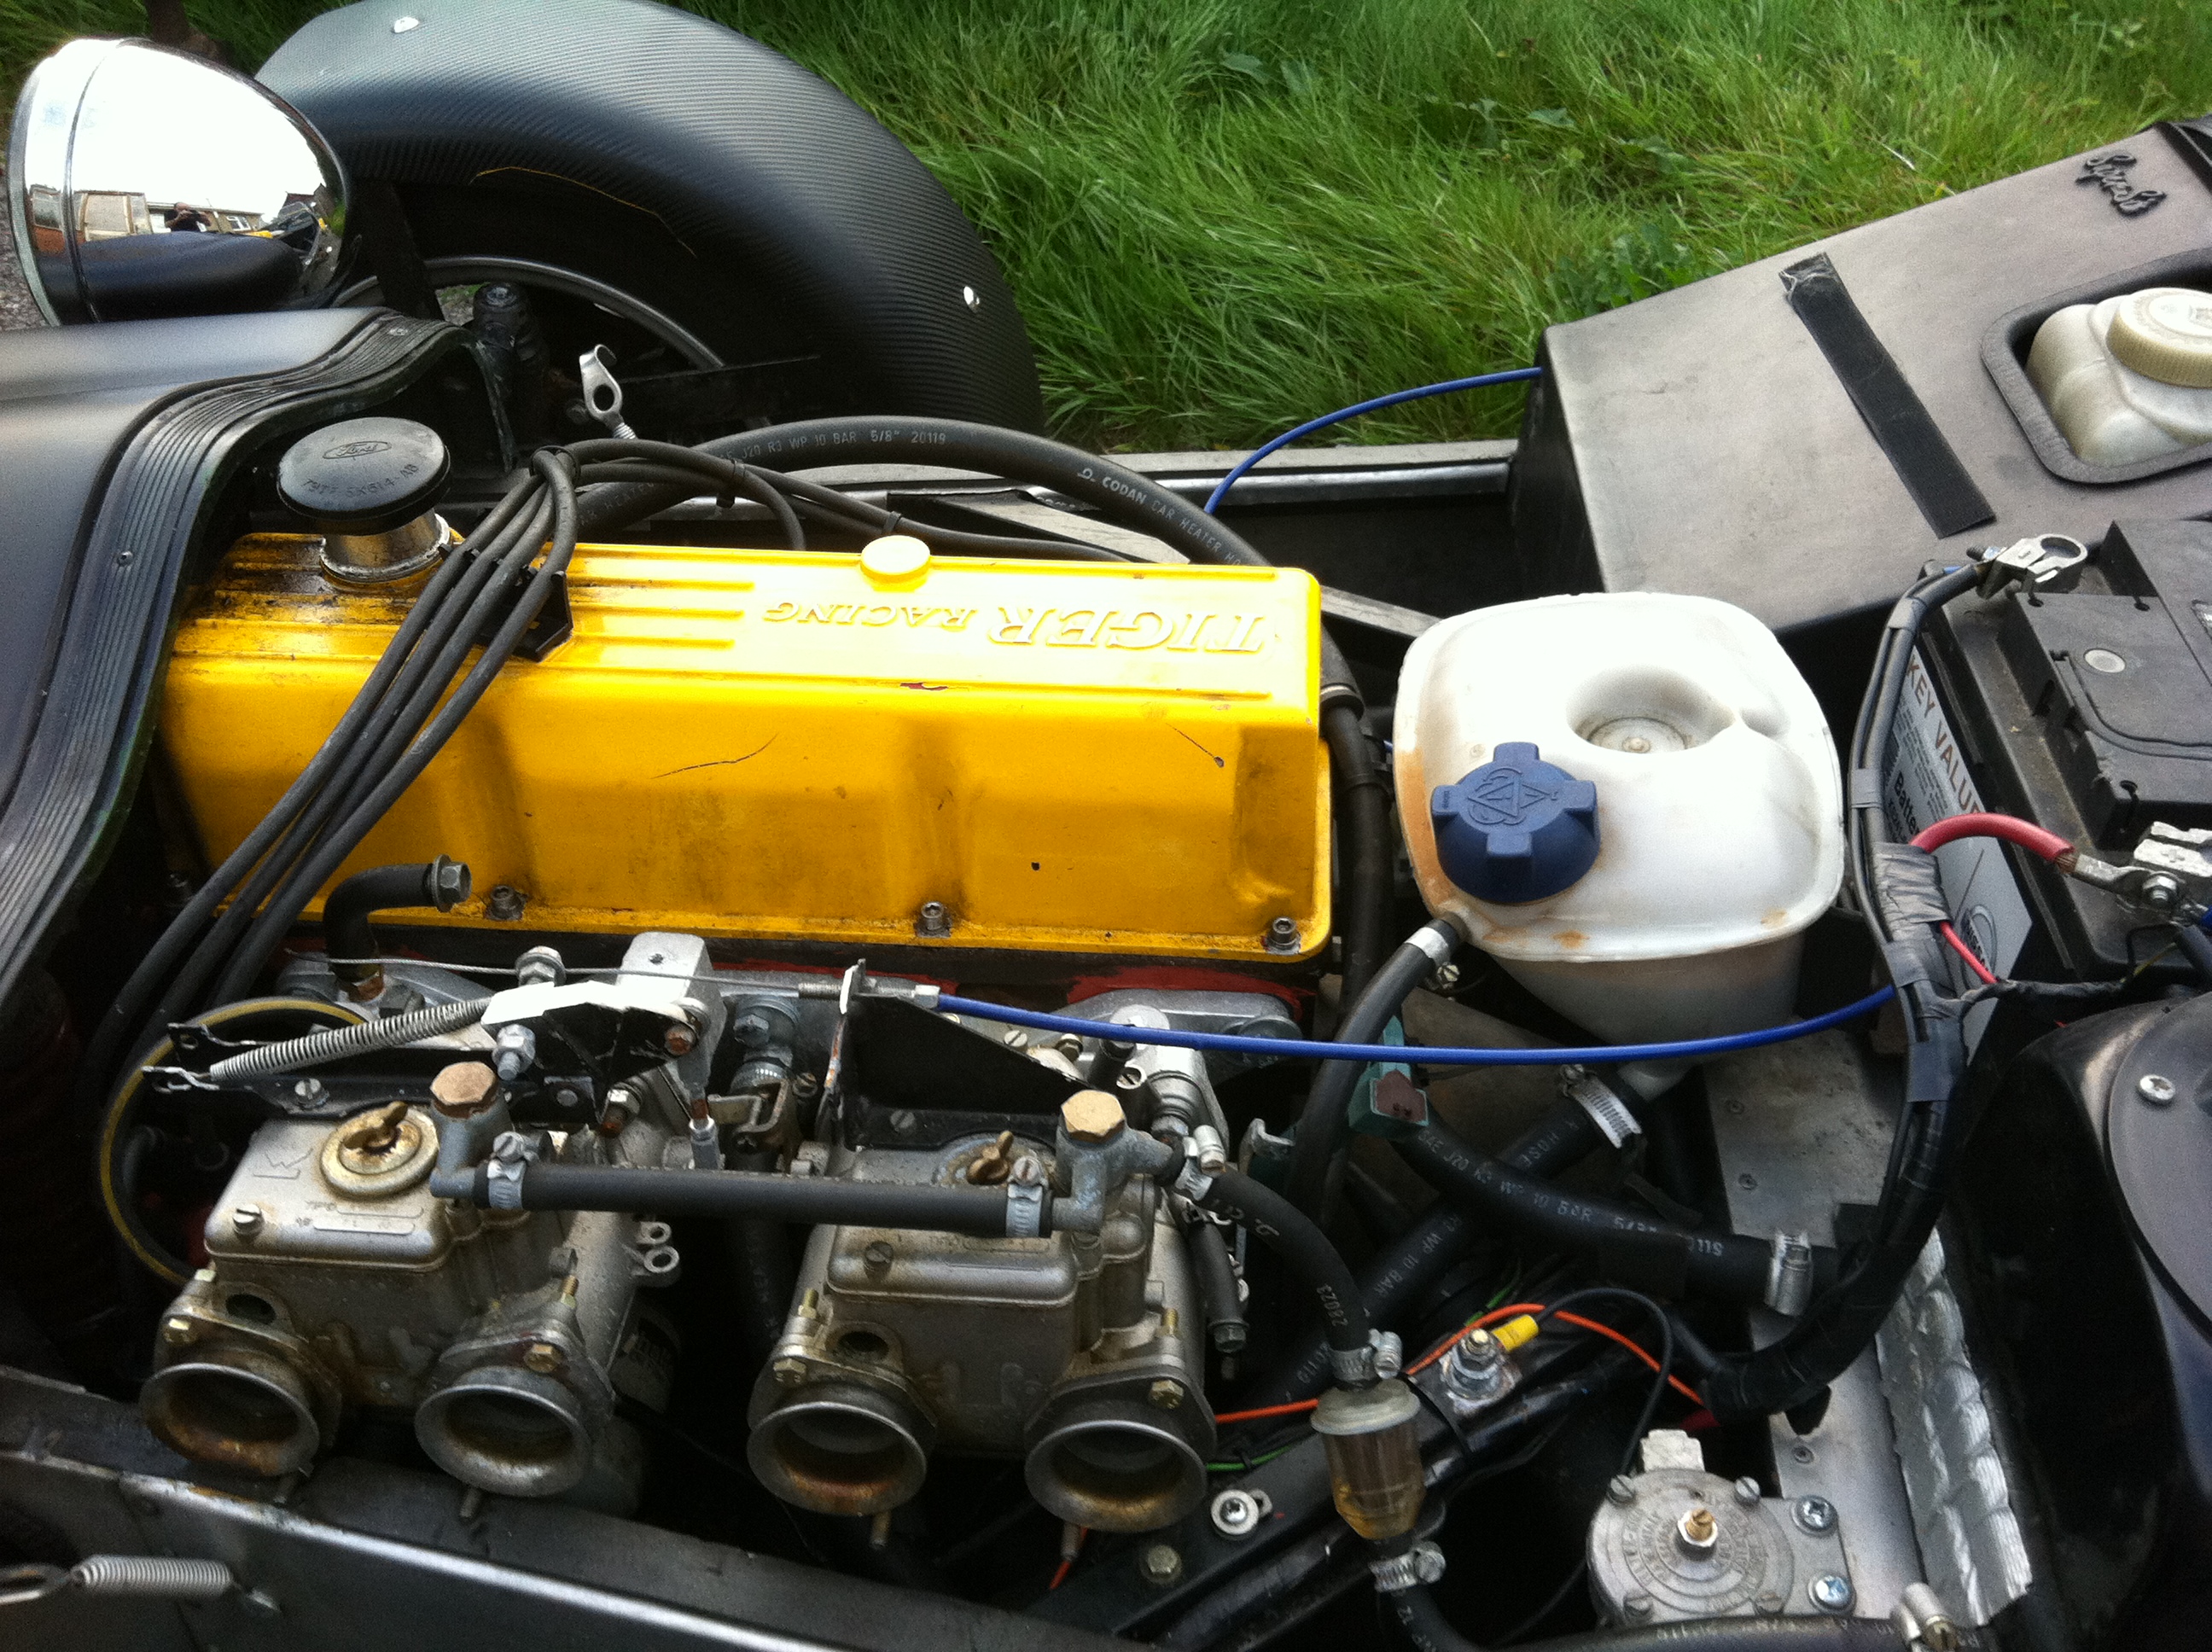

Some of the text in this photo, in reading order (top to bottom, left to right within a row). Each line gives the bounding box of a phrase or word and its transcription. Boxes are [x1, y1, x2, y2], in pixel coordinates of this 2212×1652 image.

[789, 435, 808, 451] WP
[814, 433, 826, 448] 10
[833, 431, 857, 445] BAR
[870, 429, 899, 443] 5/8"
[1101, 476, 1148, 505] CODAN
[1151, 500, 1177, 521] CAR
[1179, 519, 1222, 552] HEATER
[763, 600, 1266, 654] TIGER RACING
[1906, 655, 1936, 718] KEY
[1935, 719, 1981, 813] VALU
[1894, 771, 1920, 835] Batte
[1372, 1269, 1404, 1297] BAR
